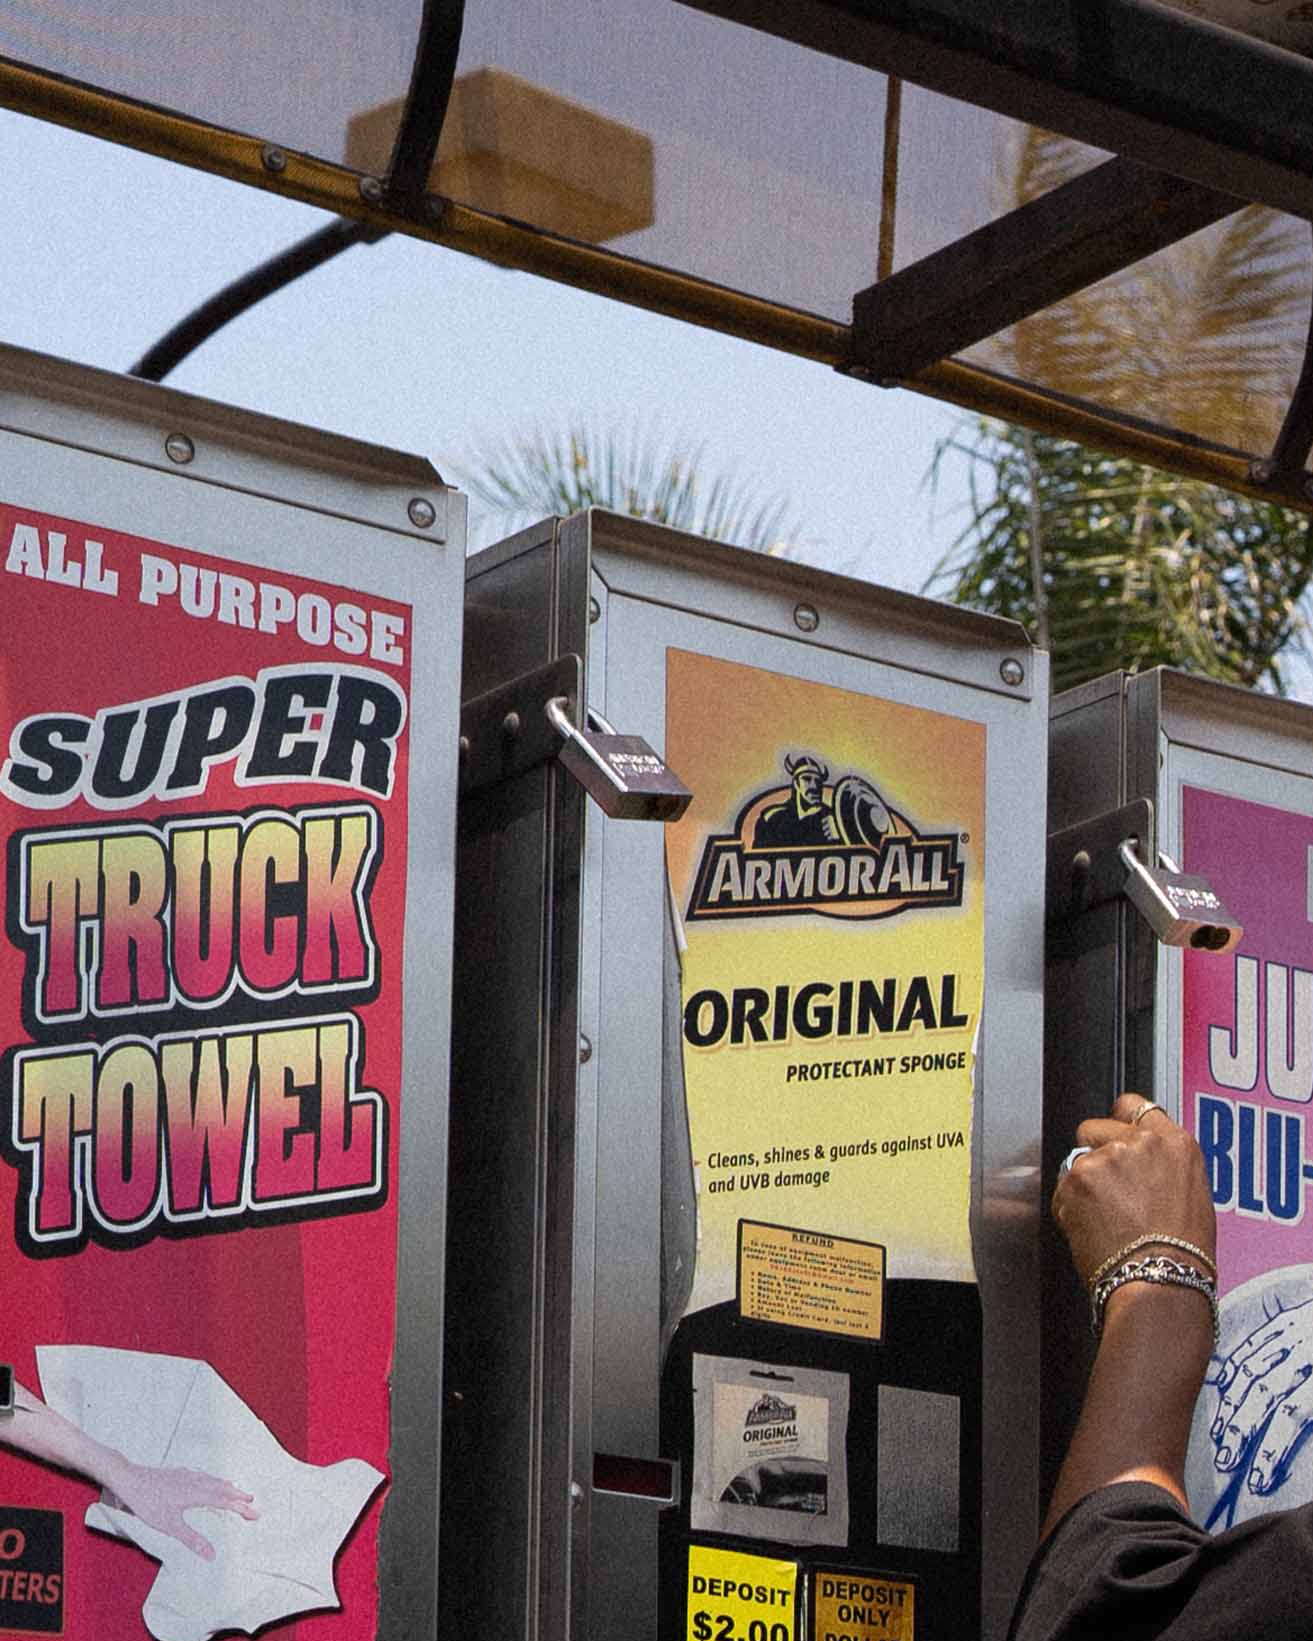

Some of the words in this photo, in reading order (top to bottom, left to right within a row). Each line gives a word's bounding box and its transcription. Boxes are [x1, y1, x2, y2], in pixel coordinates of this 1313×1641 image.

[5, 523, 118, 597] ALL
[138, 553, 405, 666] PURPOSE
[8, 672, 404, 800] SUPER
[28, 815, 369, 1014] TRUCK
[683, 975, 969, 1047] ORIGINAL
[786, 1056, 895, 1084] PROTECTANT
[900, 1051, 966, 1074] SPONGE
[22, 1024, 379, 1236] TOWEL
[708, 1147, 758, 1169] Cleans,
[763, 1145, 809, 1165] shines
[814, 1144, 825, 1159] &
[829, 1136, 877, 1160] guards
[882, 1134, 932, 1157] against
[936, 1131, 964, 1148] UVA
[709, 1177, 735, 1193] and
[739, 1173, 770, 1189] UVB
[775, 1168, 830, 1191] damage
[743, 1425, 798, 1442] ORIGINAL
[692, 1575, 790, 1605] DEPOSIT
[821, 1580, 908, 1606] DEPOSIT
[837, 1603, 890, 1629] ONLY
